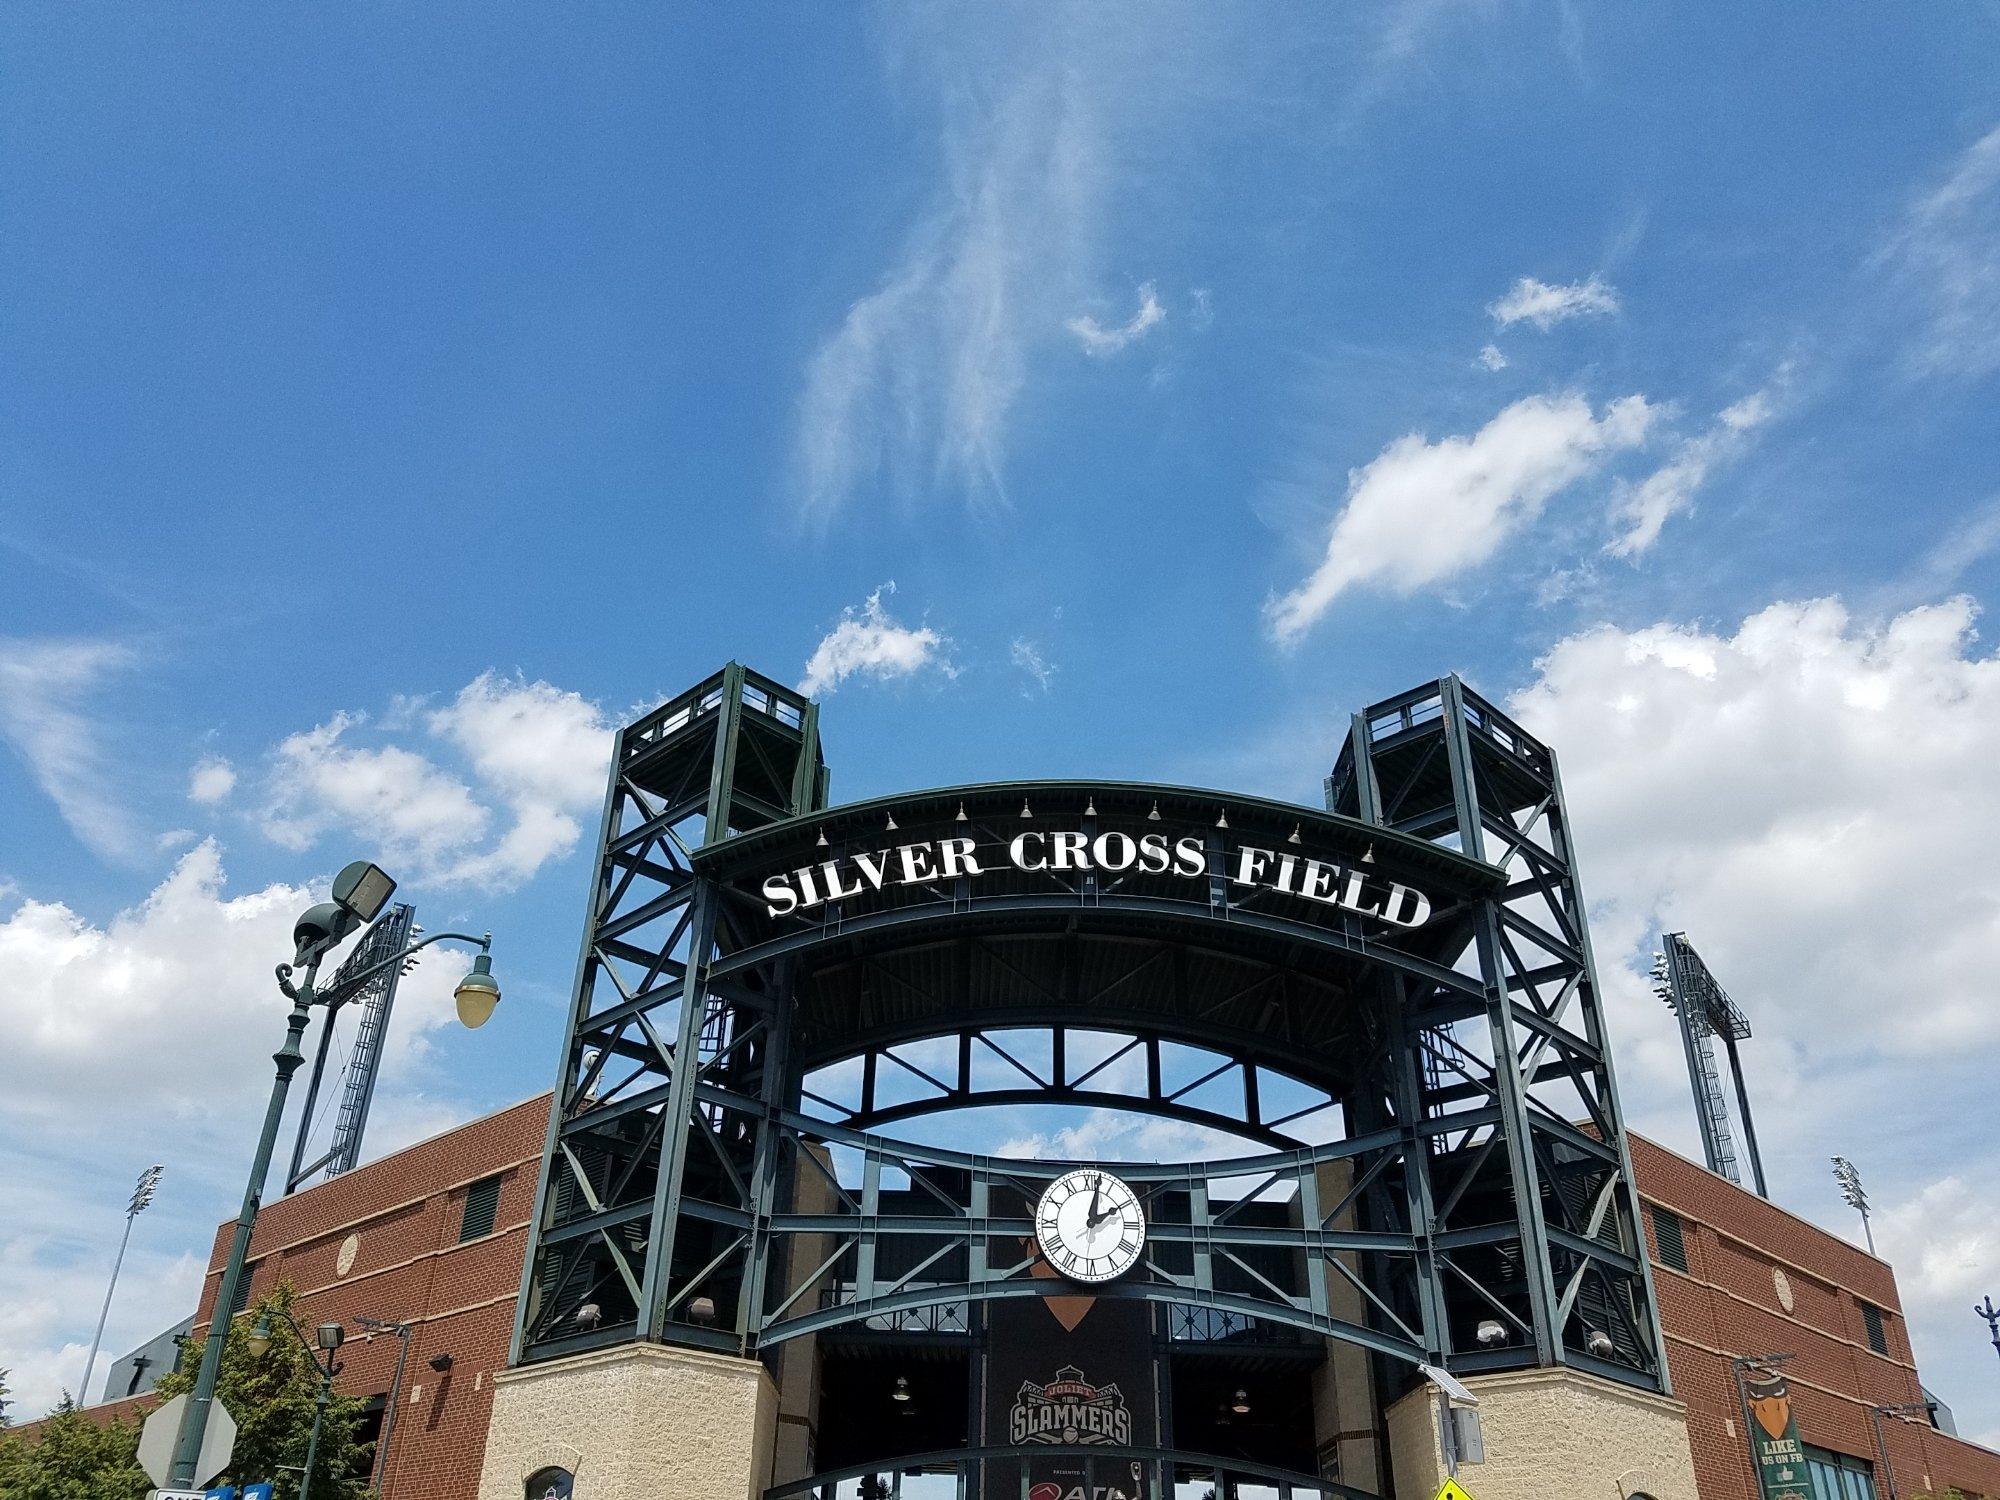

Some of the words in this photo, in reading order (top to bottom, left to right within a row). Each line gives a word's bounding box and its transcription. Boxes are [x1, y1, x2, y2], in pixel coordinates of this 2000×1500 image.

[762, 836, 984, 919] SILVER
[1010, 831, 1206, 878] CROSS
[1235, 845, 1431, 929] FIELD
[1049, 1384, 1092, 1396] JOLIET
[1013, 1405, 1128, 1444] SLAMMERS
[1763, 1439, 1796, 1454] LIKE
[1762, 1456, 1774, 1465] US
[1776, 1455, 1788, 1463] ON
[1790, 1454, 1804, 1462] FB
